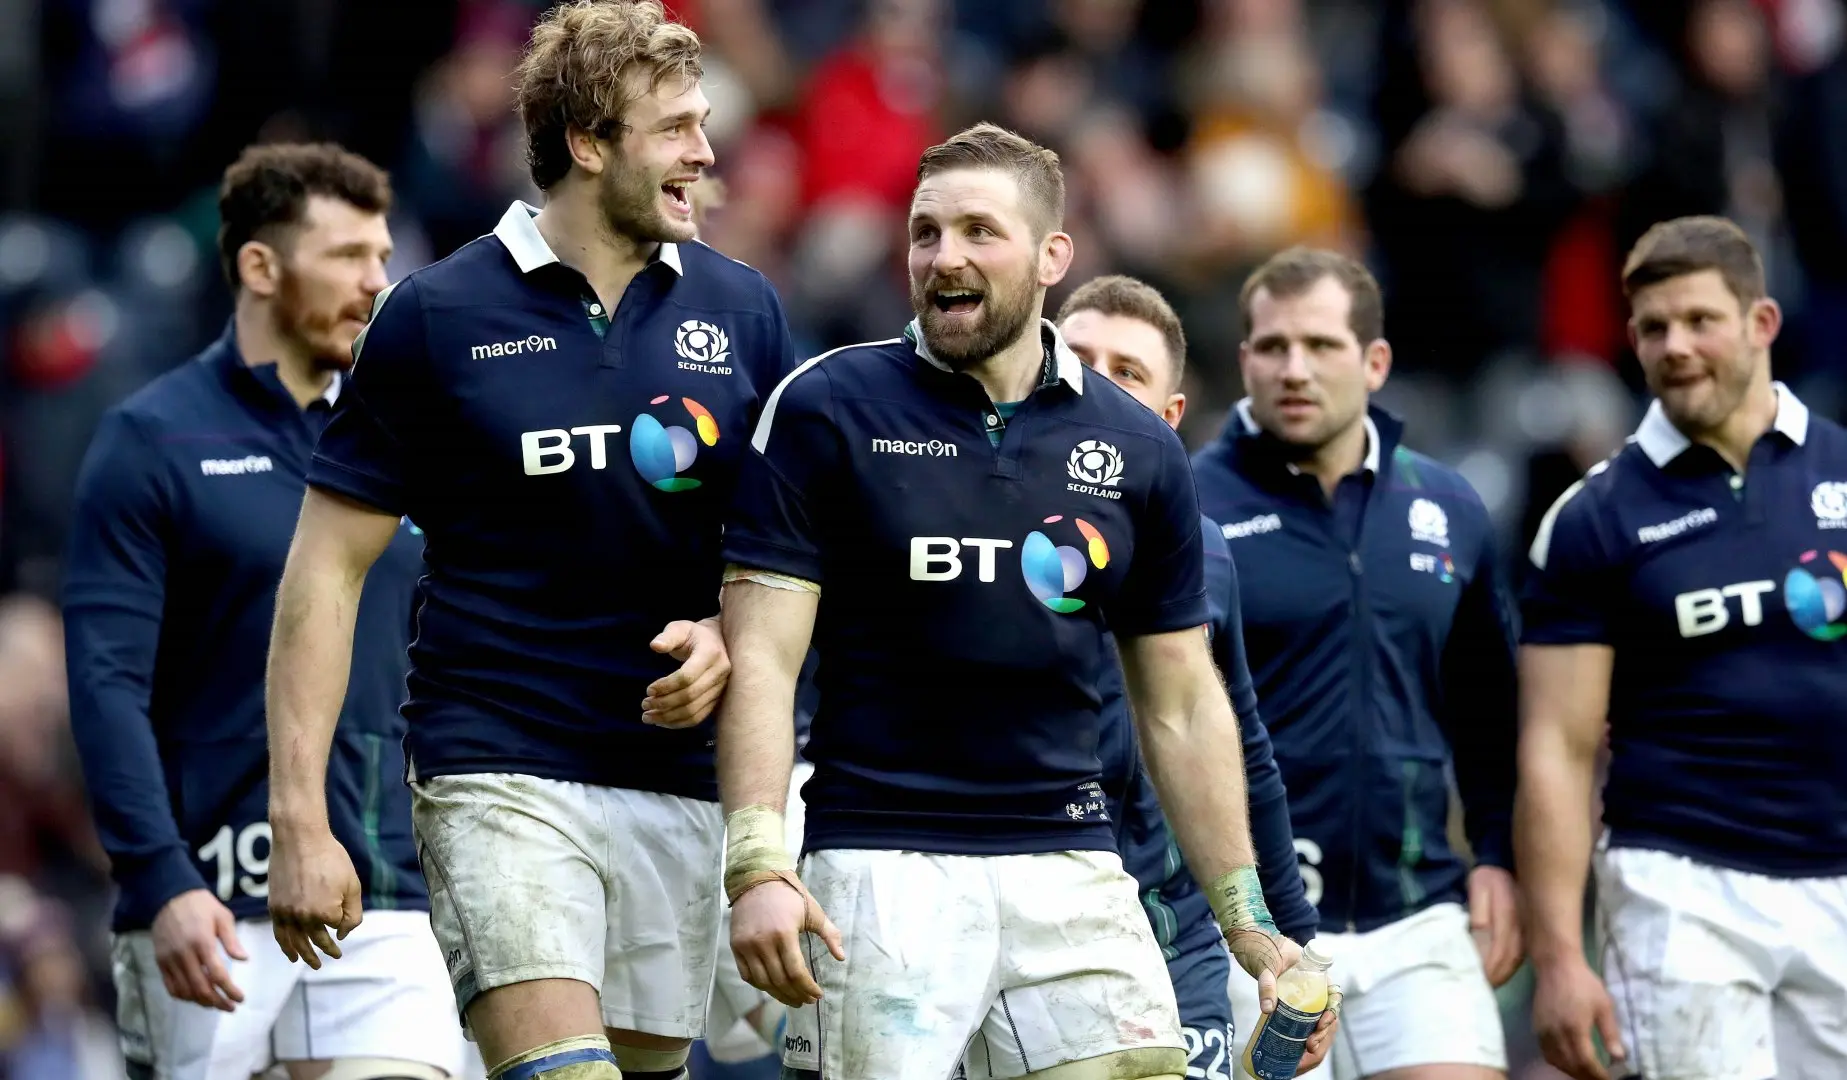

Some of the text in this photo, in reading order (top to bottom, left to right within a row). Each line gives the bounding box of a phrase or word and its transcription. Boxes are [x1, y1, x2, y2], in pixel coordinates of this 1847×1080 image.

[471, 335, 557, 360] macron
[677, 361, 732, 375] SCOTLAND
[200, 455, 274, 476] macron
[520, 424, 622, 476] BT
[872, 438, 958, 457] macron
[1066, 482, 1122, 500] SCOTLAND
[1637, 507, 1718, 544] macron
[909, 536, 1013, 583] BT
[1674, 579, 1777, 638] BT
[197, 821, 273, 901] 19
[1179, 1026, 1231, 1080] 22
